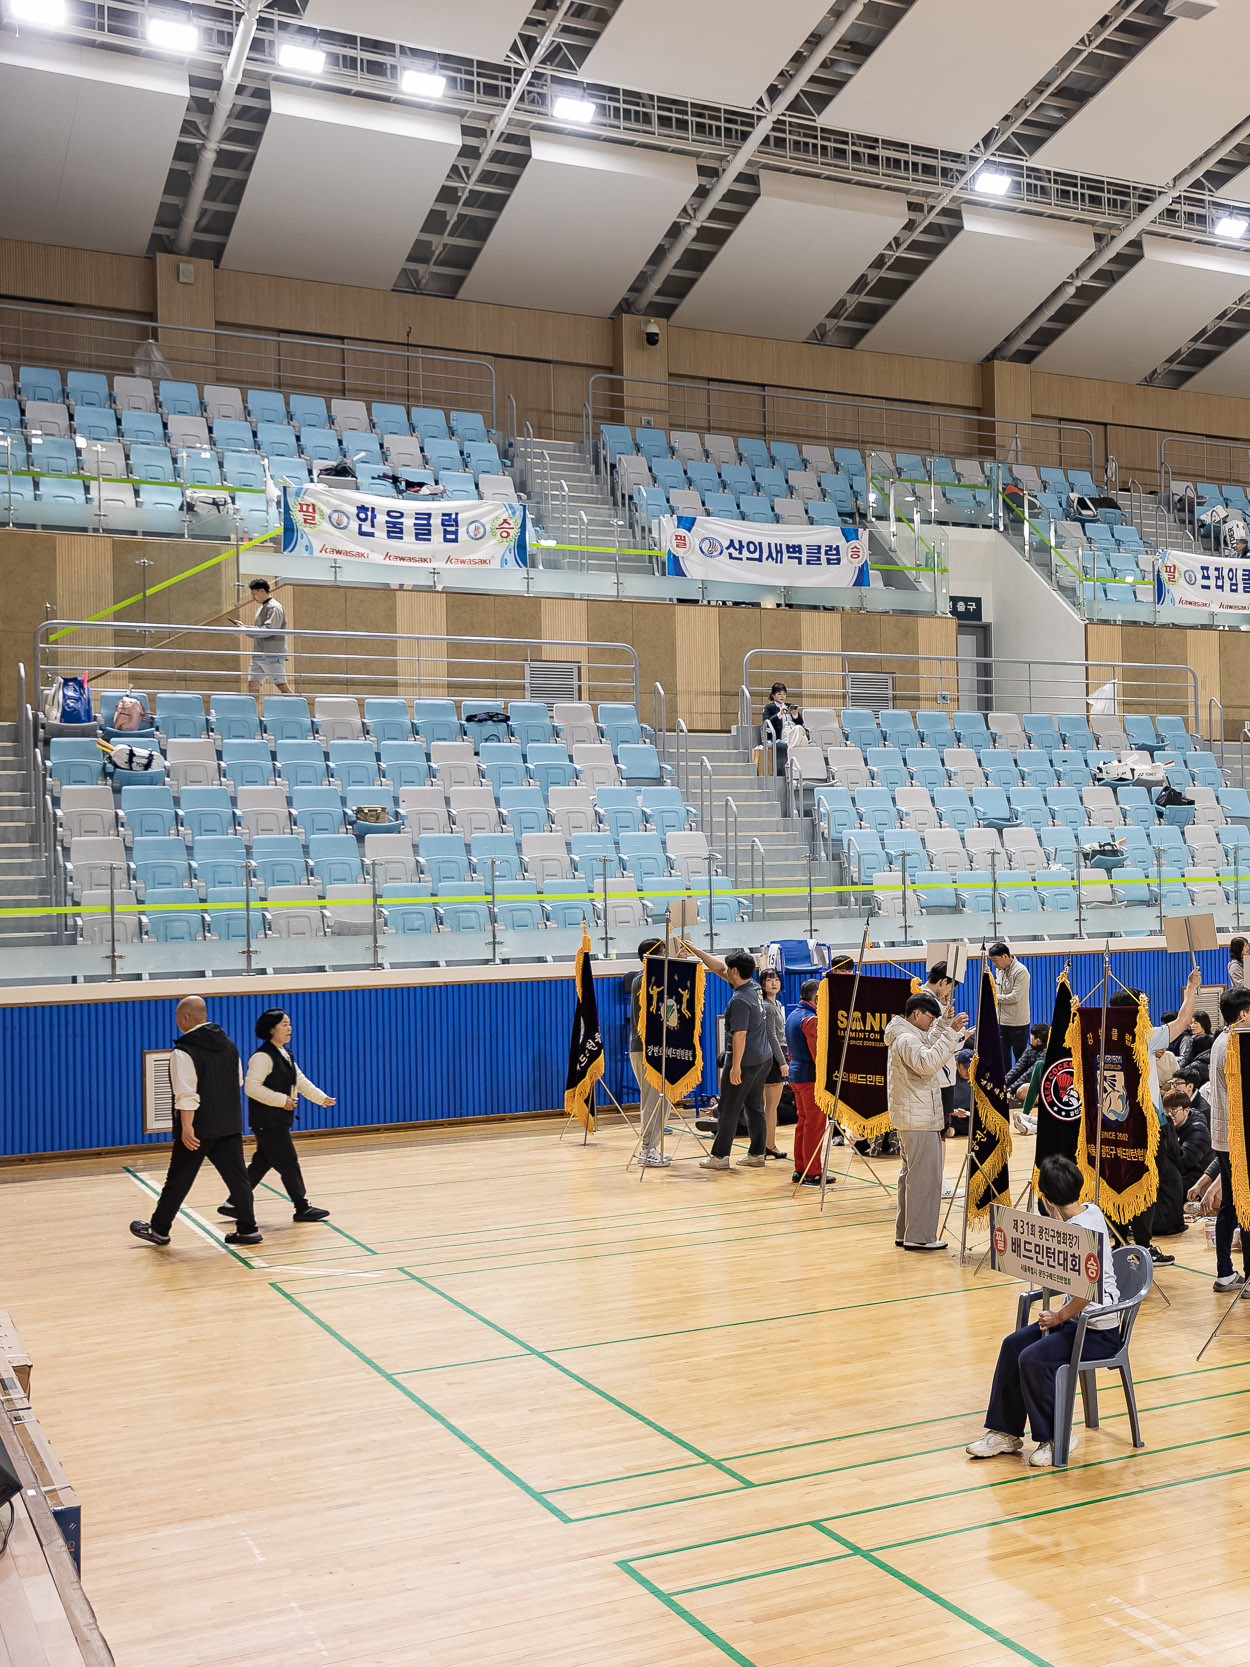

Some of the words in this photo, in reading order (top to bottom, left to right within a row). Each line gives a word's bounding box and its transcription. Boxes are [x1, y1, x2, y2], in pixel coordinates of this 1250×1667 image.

[298, 502, 316, 525] 필
[356, 504, 459, 544] 한울클럽
[496, 518, 514, 539] 승
[674, 534, 687, 549] 필
[725, 538, 841, 566] 산의새벽클럽
[850, 545, 861, 560] 승
[1164, 564, 1177, 583] 필
[956, 601, 977, 612] 출구
[1044, 1081, 1053, 1103] RED
[995, 1230, 1005, 1251] 필
[1012, 1218, 1036, 1238] 제31회
[1038, 1226, 1080, 1250] 광진구협회장기
[1011, 1237, 1081, 1276] 배드민턴대회
[1087, 1257, 1098, 1278] 승
